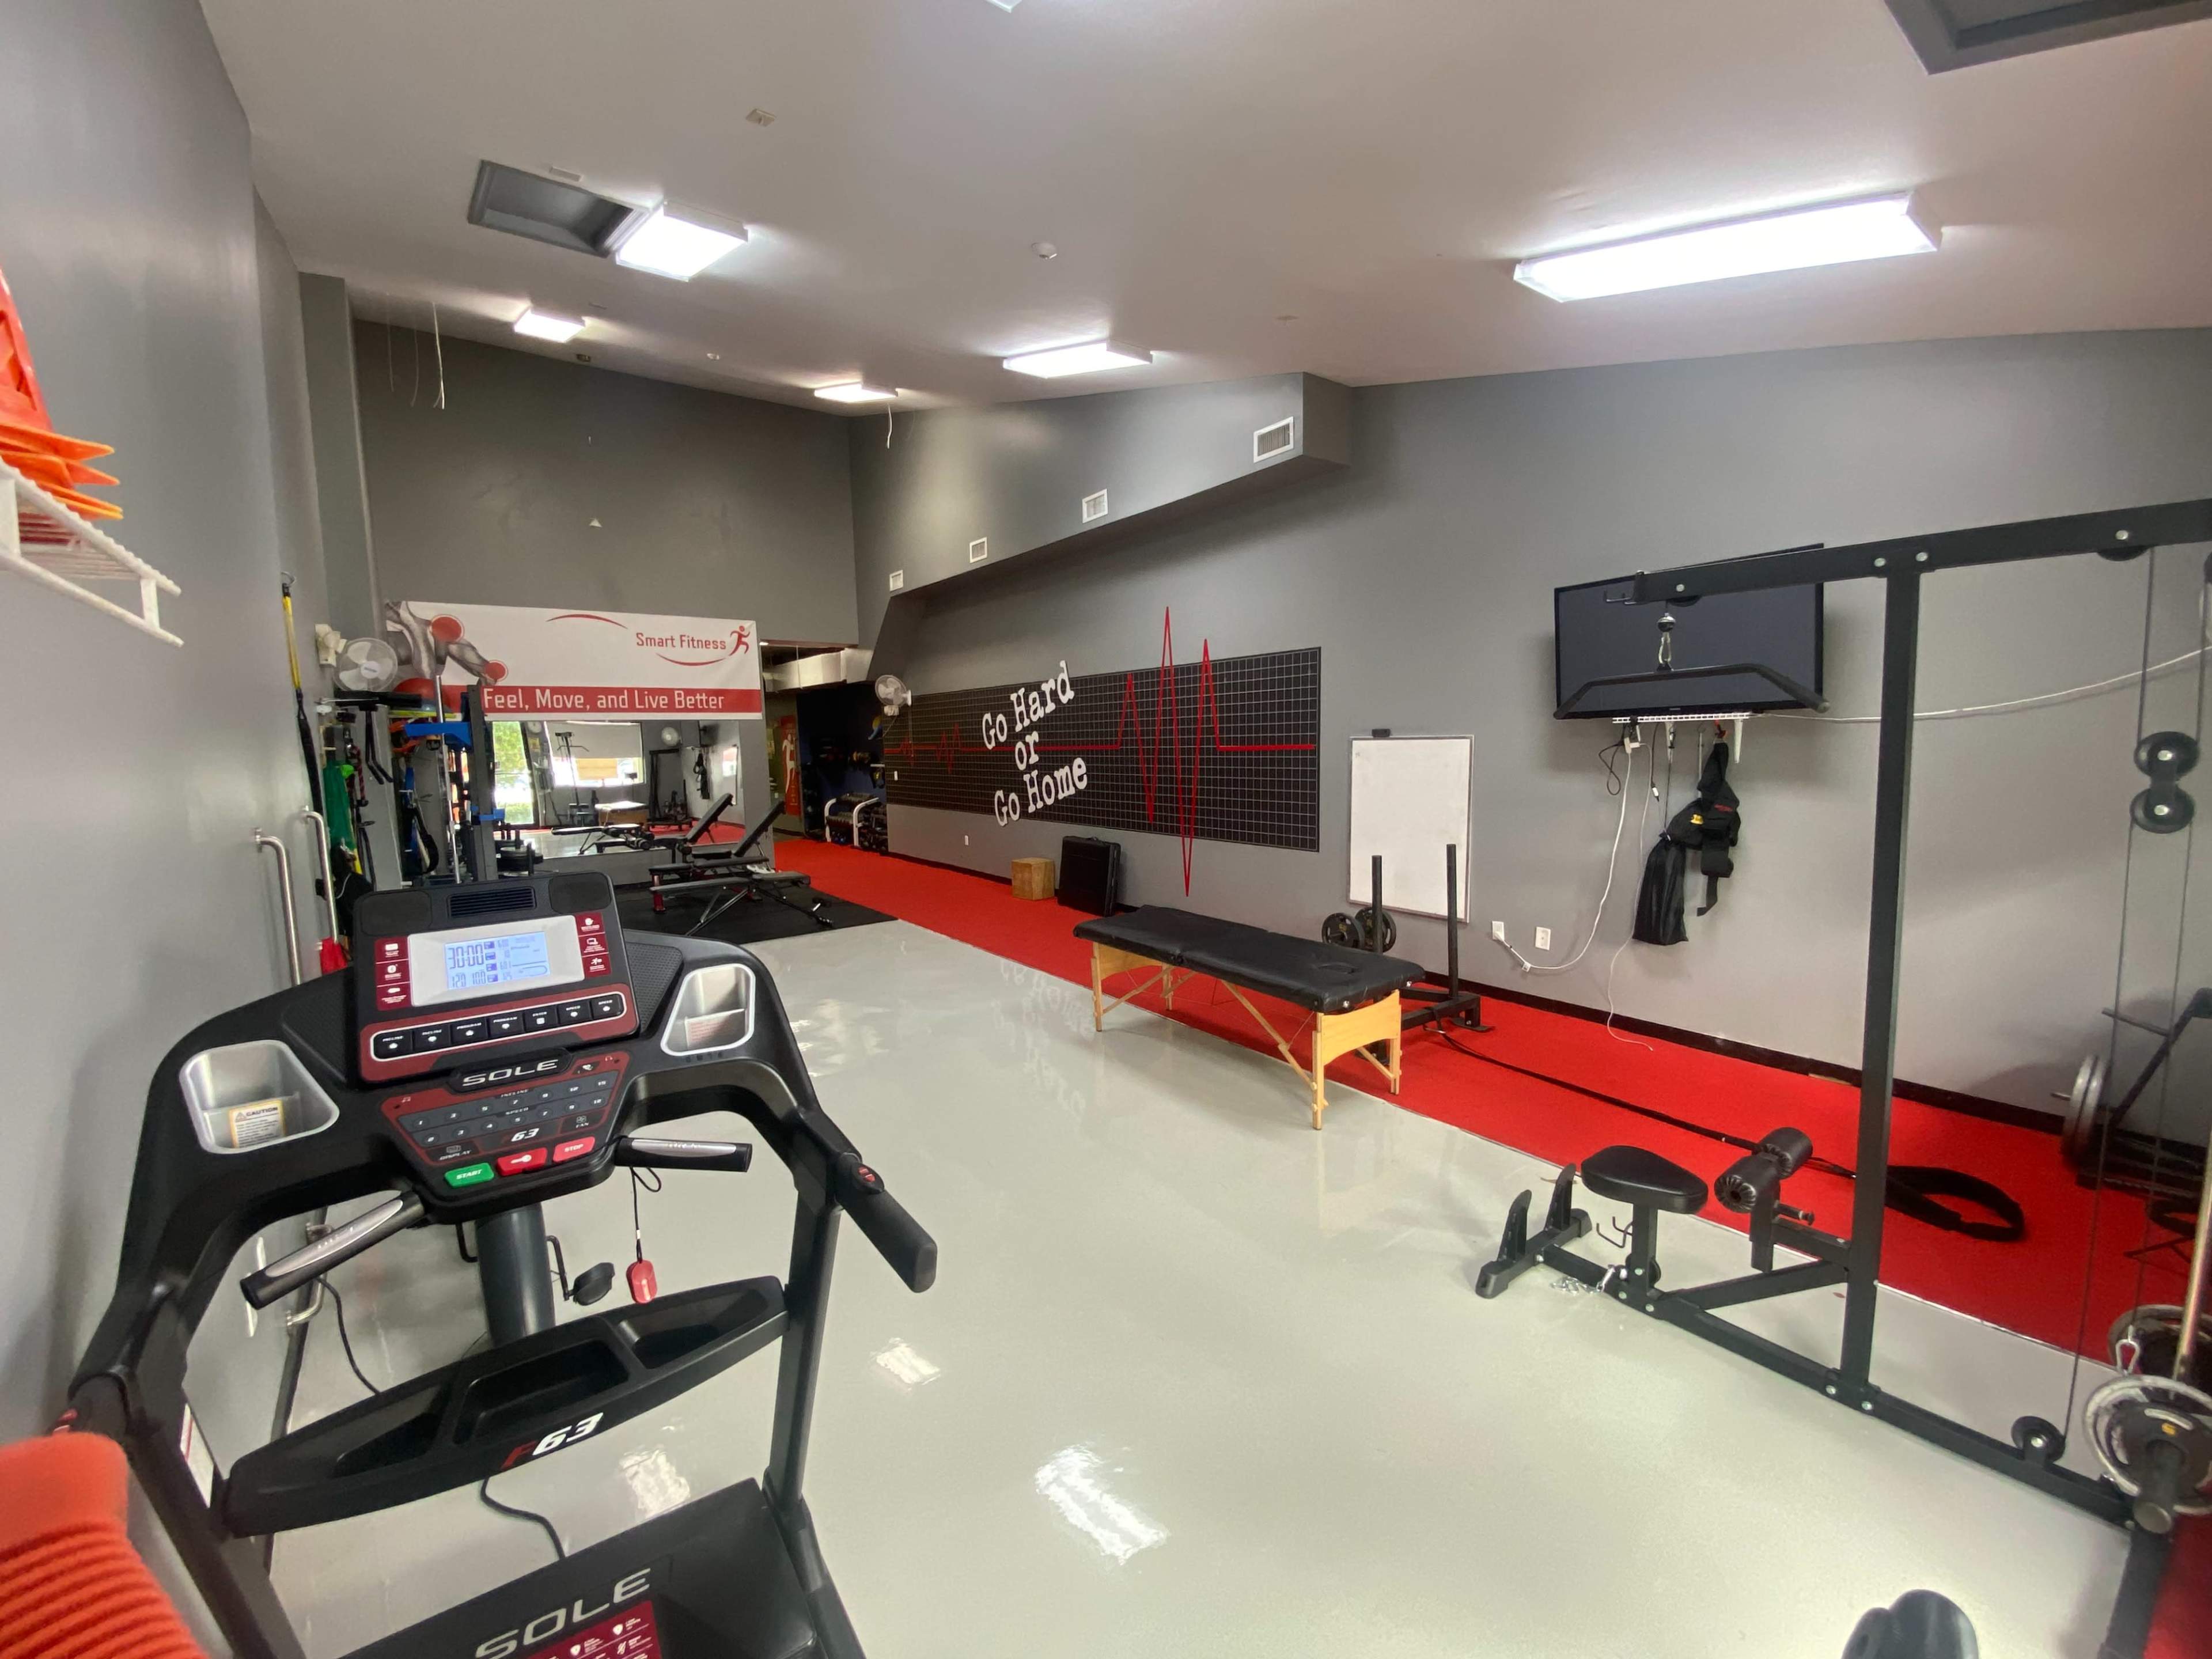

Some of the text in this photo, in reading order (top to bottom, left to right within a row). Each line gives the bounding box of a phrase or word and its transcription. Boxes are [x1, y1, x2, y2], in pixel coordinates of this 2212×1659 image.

[637, 632, 726, 650] Smart Fitness
[483, 687, 725, 711] Feel, Move, and Live Better
[982, 660, 1075, 750] Go Hard
[1014, 731, 1040, 771] or
[994, 756, 1088, 827] Go Home
[448, 944, 484, 969] 30:00
[463, 1059, 559, 1086] SOLE
[246, 1107, 278, 1117] CAUTION
[511, 1128, 540, 1142] 63
[440, 1150, 472, 1161] DISPLAY
[564, 1143, 584, 1153] STOP
[456, 1168, 483, 1180] START
[500, 1411, 604, 1471] F63
[475, 1567, 651, 1659] SOLE
